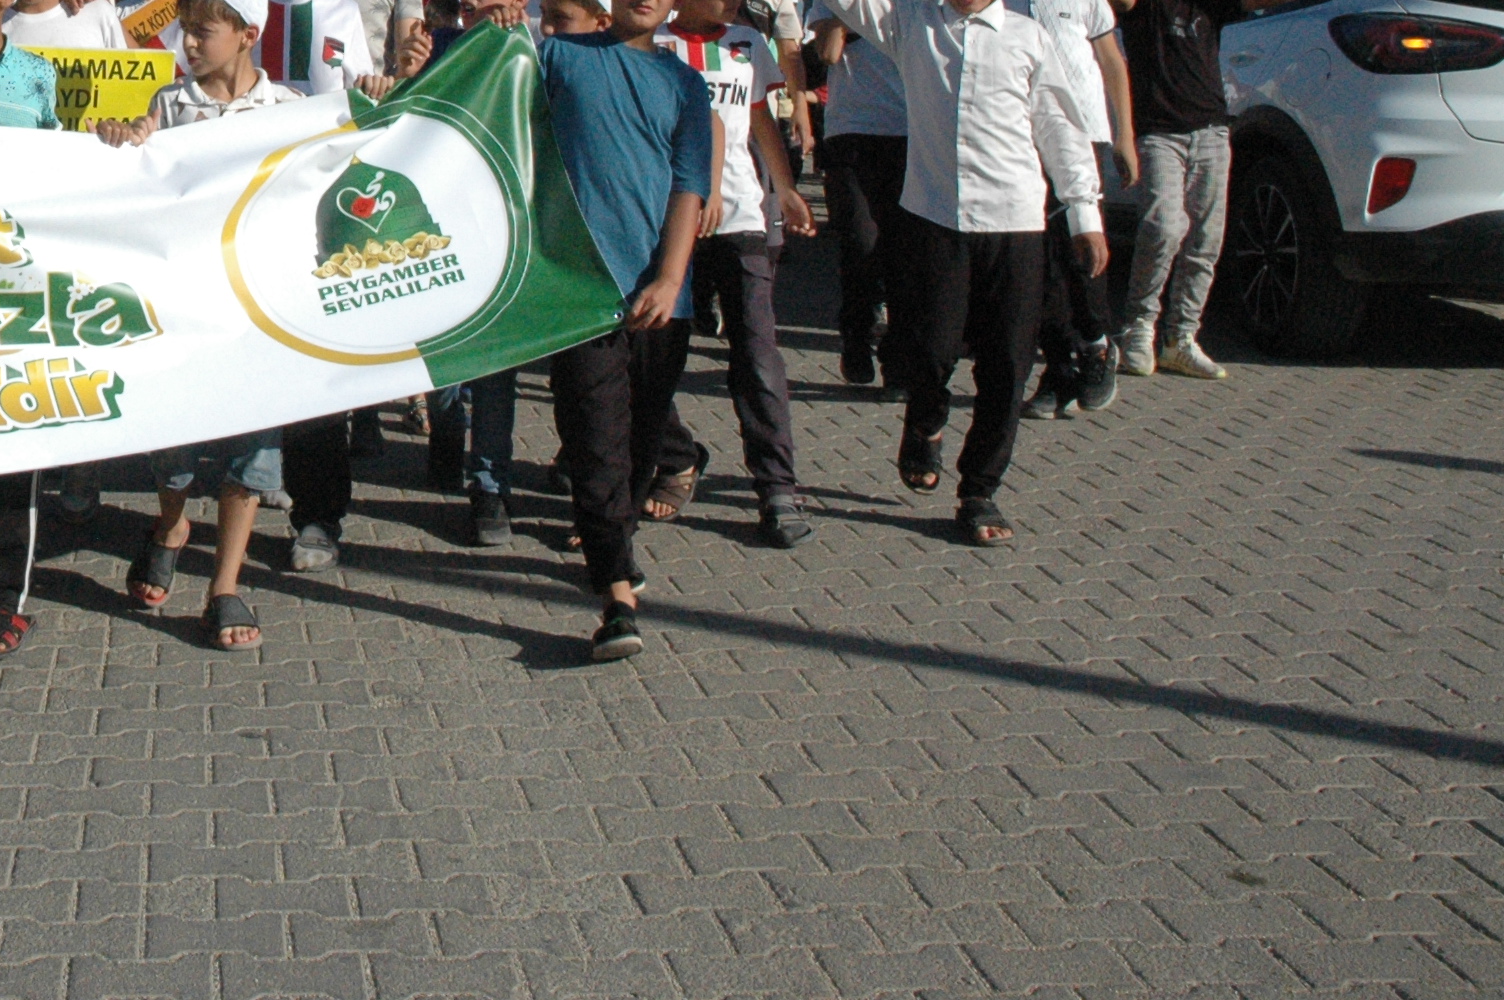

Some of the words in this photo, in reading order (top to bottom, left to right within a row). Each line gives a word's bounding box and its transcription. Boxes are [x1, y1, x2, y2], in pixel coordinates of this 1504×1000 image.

[52, 57, 156, 80] NAMAZA
[56, 85, 99, 108] YDİ
[318, 253, 459, 300] PEYGAMBER
[322, 268, 465, 316] SEVDALILARI
